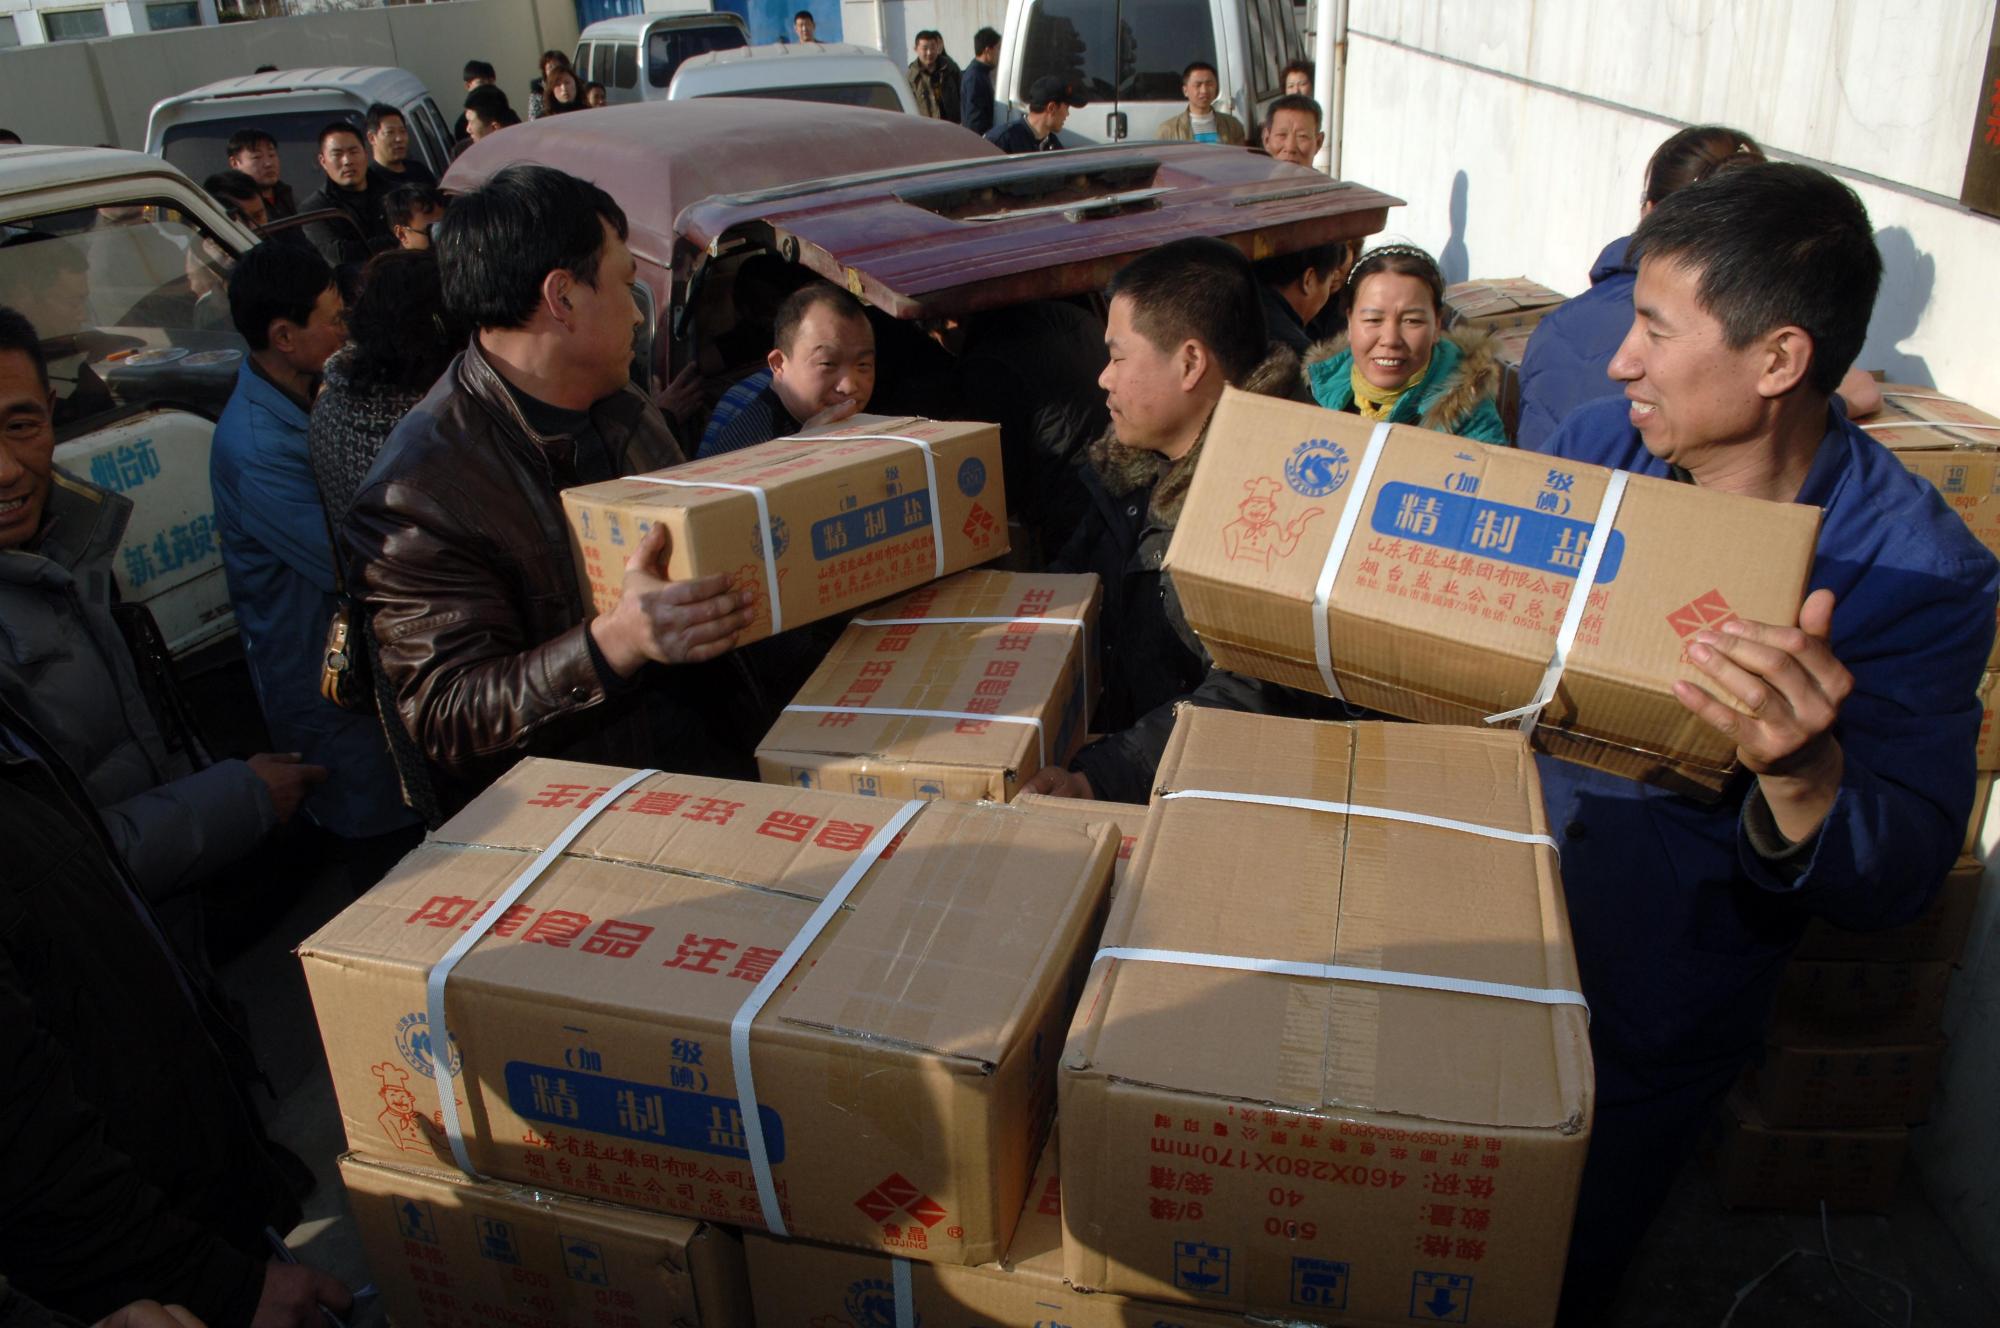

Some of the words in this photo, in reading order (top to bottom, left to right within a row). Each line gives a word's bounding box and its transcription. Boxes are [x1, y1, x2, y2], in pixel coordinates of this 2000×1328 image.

[1394, 493, 1592, 570] 精制盐
[1367, 537, 1612, 611] 山东省盐业集团有限公司制
[528, 1072, 750, 1152] 精制盐
[1268, 1187, 1306, 1208] 40
[1264, 1215, 1318, 1242] 500
[883, 1236, 928, 1250] LUJING
[1302, 1286, 1333, 1303] 10
